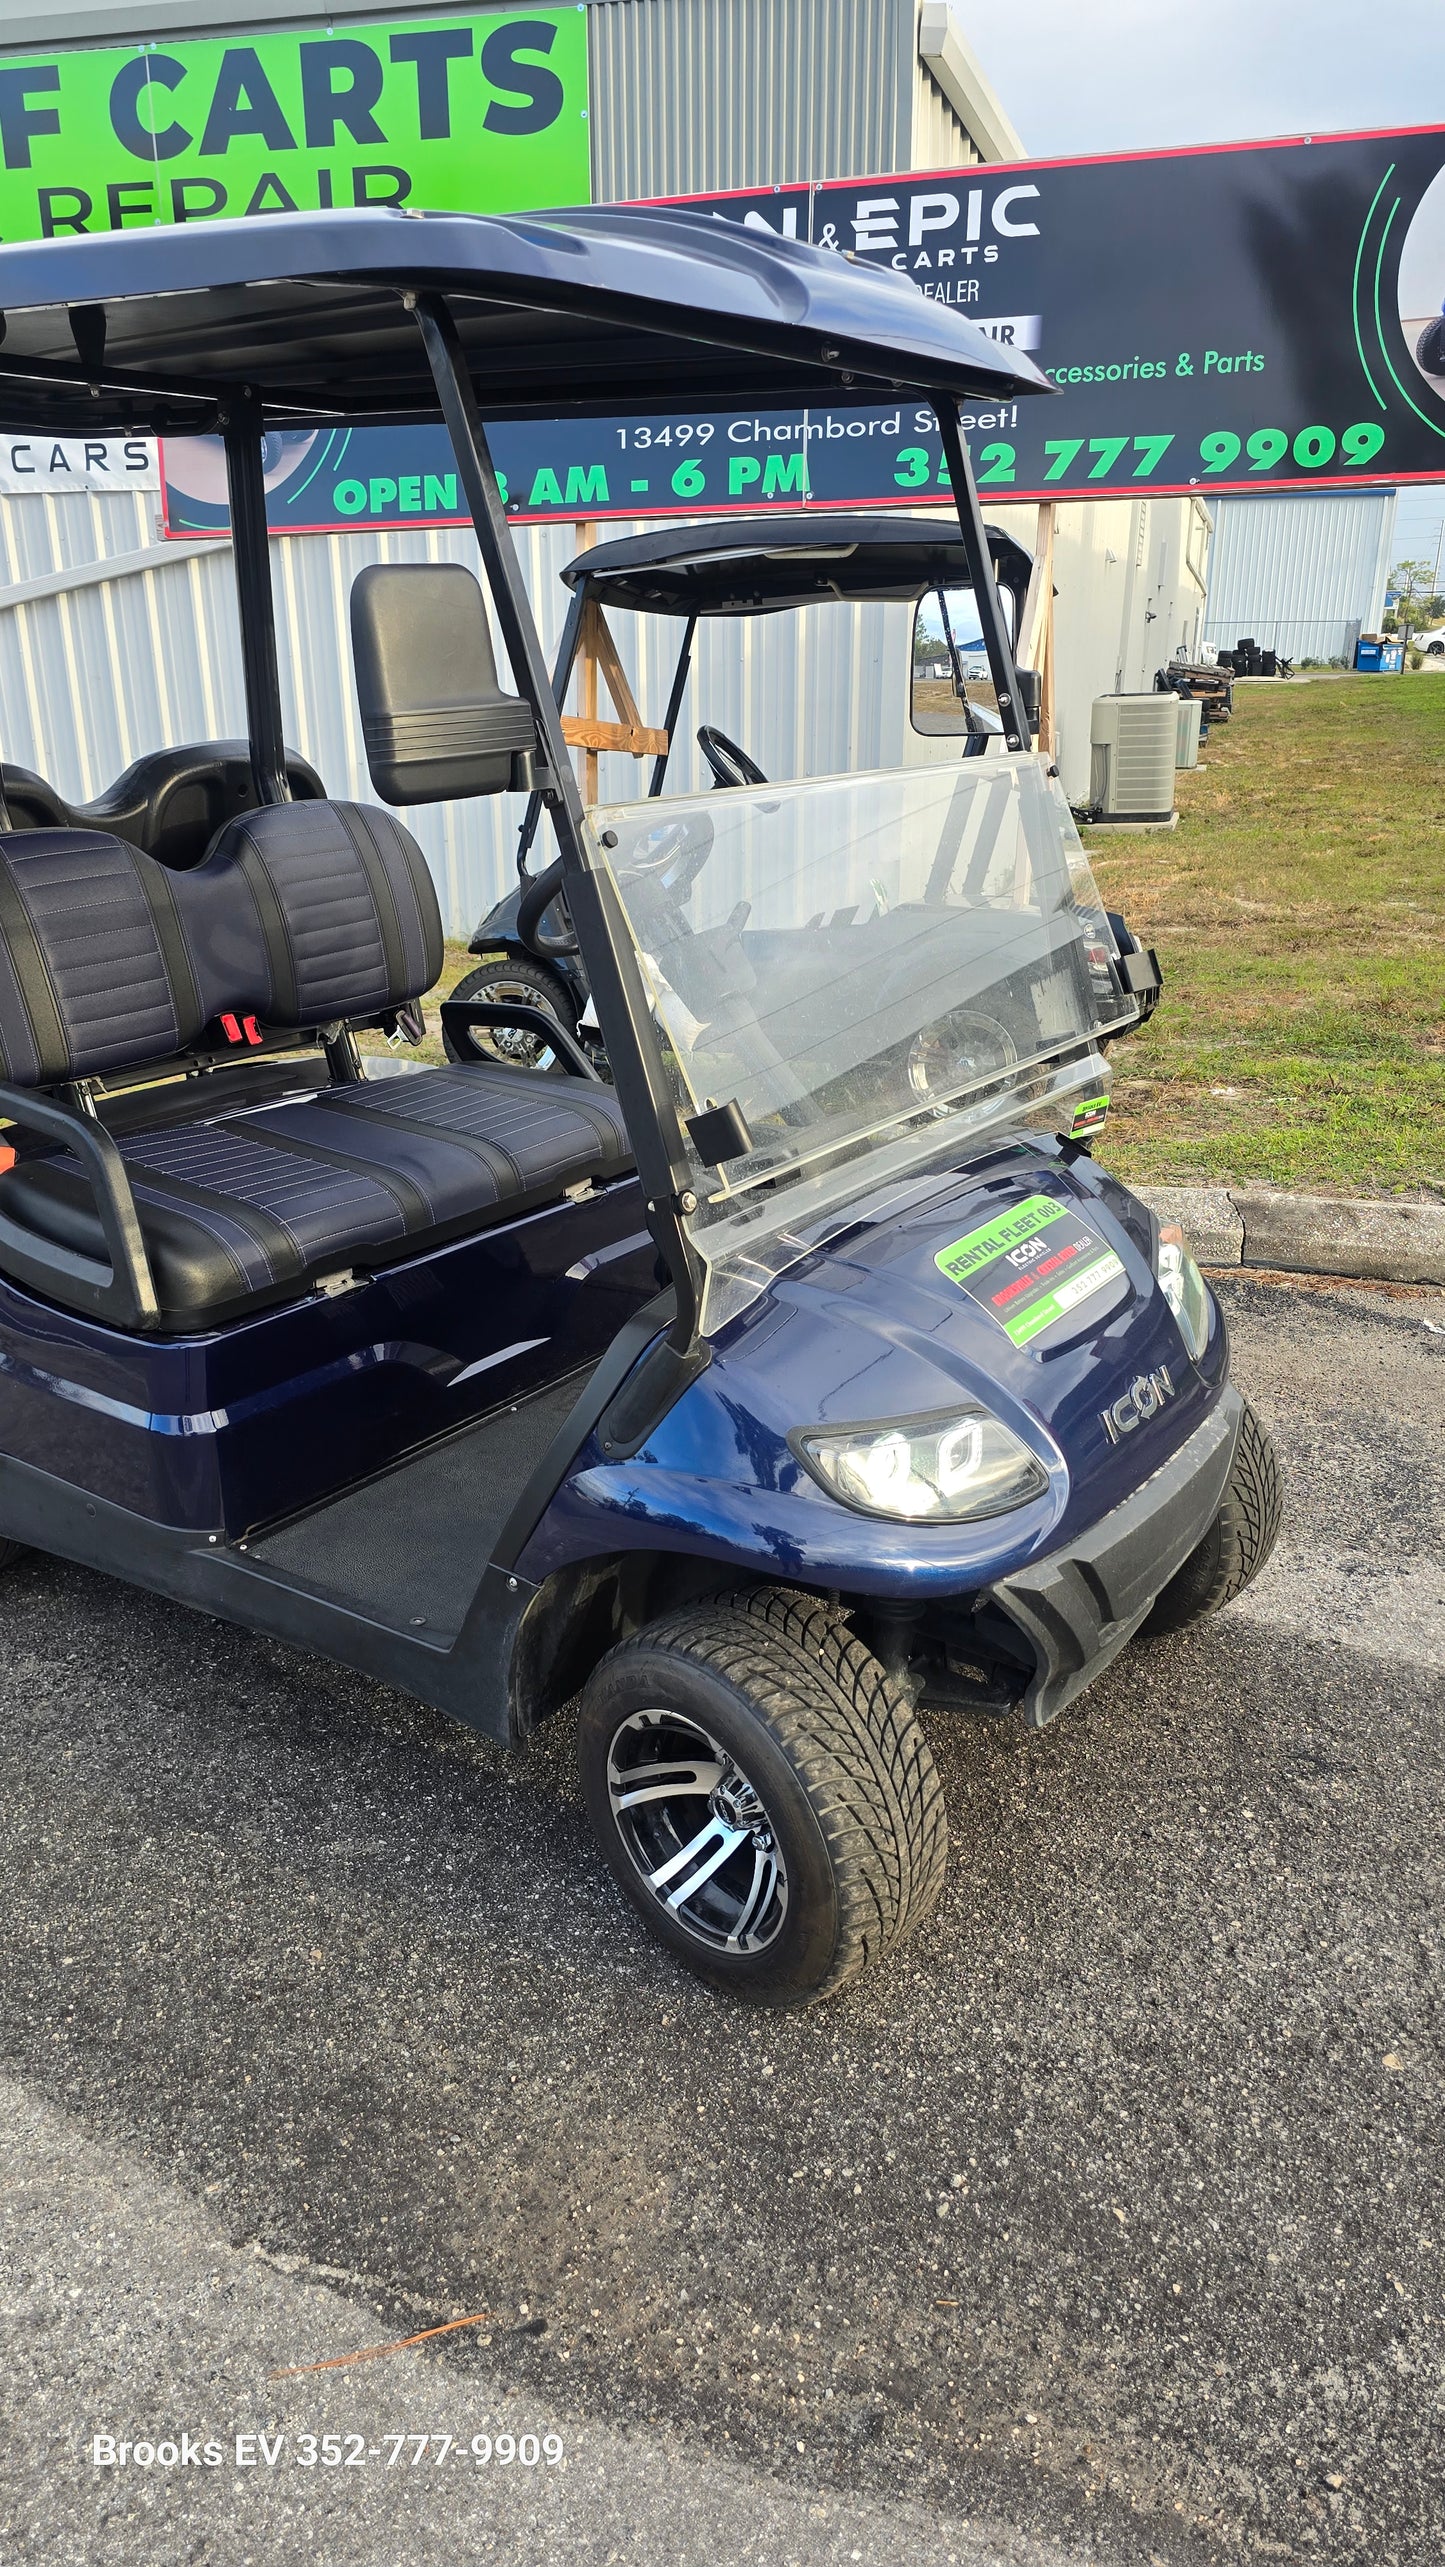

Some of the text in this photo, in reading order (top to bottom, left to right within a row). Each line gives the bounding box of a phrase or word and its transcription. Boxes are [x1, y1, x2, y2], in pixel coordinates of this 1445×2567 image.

[109, 20, 565, 162] CARTS
[37, 165, 412, 239] REPAIR
[818, 223, 839, 251] &
[850, 184, 1041, 251] EPIC
[891, 245, 999, 271] CARTS
[1175, 353, 1194, 377] &
[1203, 350, 1265, 375] Parts
[10, 441, 149, 473] CARS
[616, 405, 1018, 450] 13499 Chambord Steet!
[1044, 434, 1176, 481] 777
[1200, 422, 1386, 474] 9909
[333, 473, 458, 515] OPEN
[528, 464, 610, 506] AM
[671, 459, 706, 497] 6
[729, 453, 811, 495] PM
[945, 1236, 1007, 1277] RENTAL
[998, 1211, 1042, 1243] FLEET
[1036, 1201, 1062, 1219] 003
[1004, 1236, 1048, 1268] ICON
[1097, 1363, 1177, 1446] ICON
